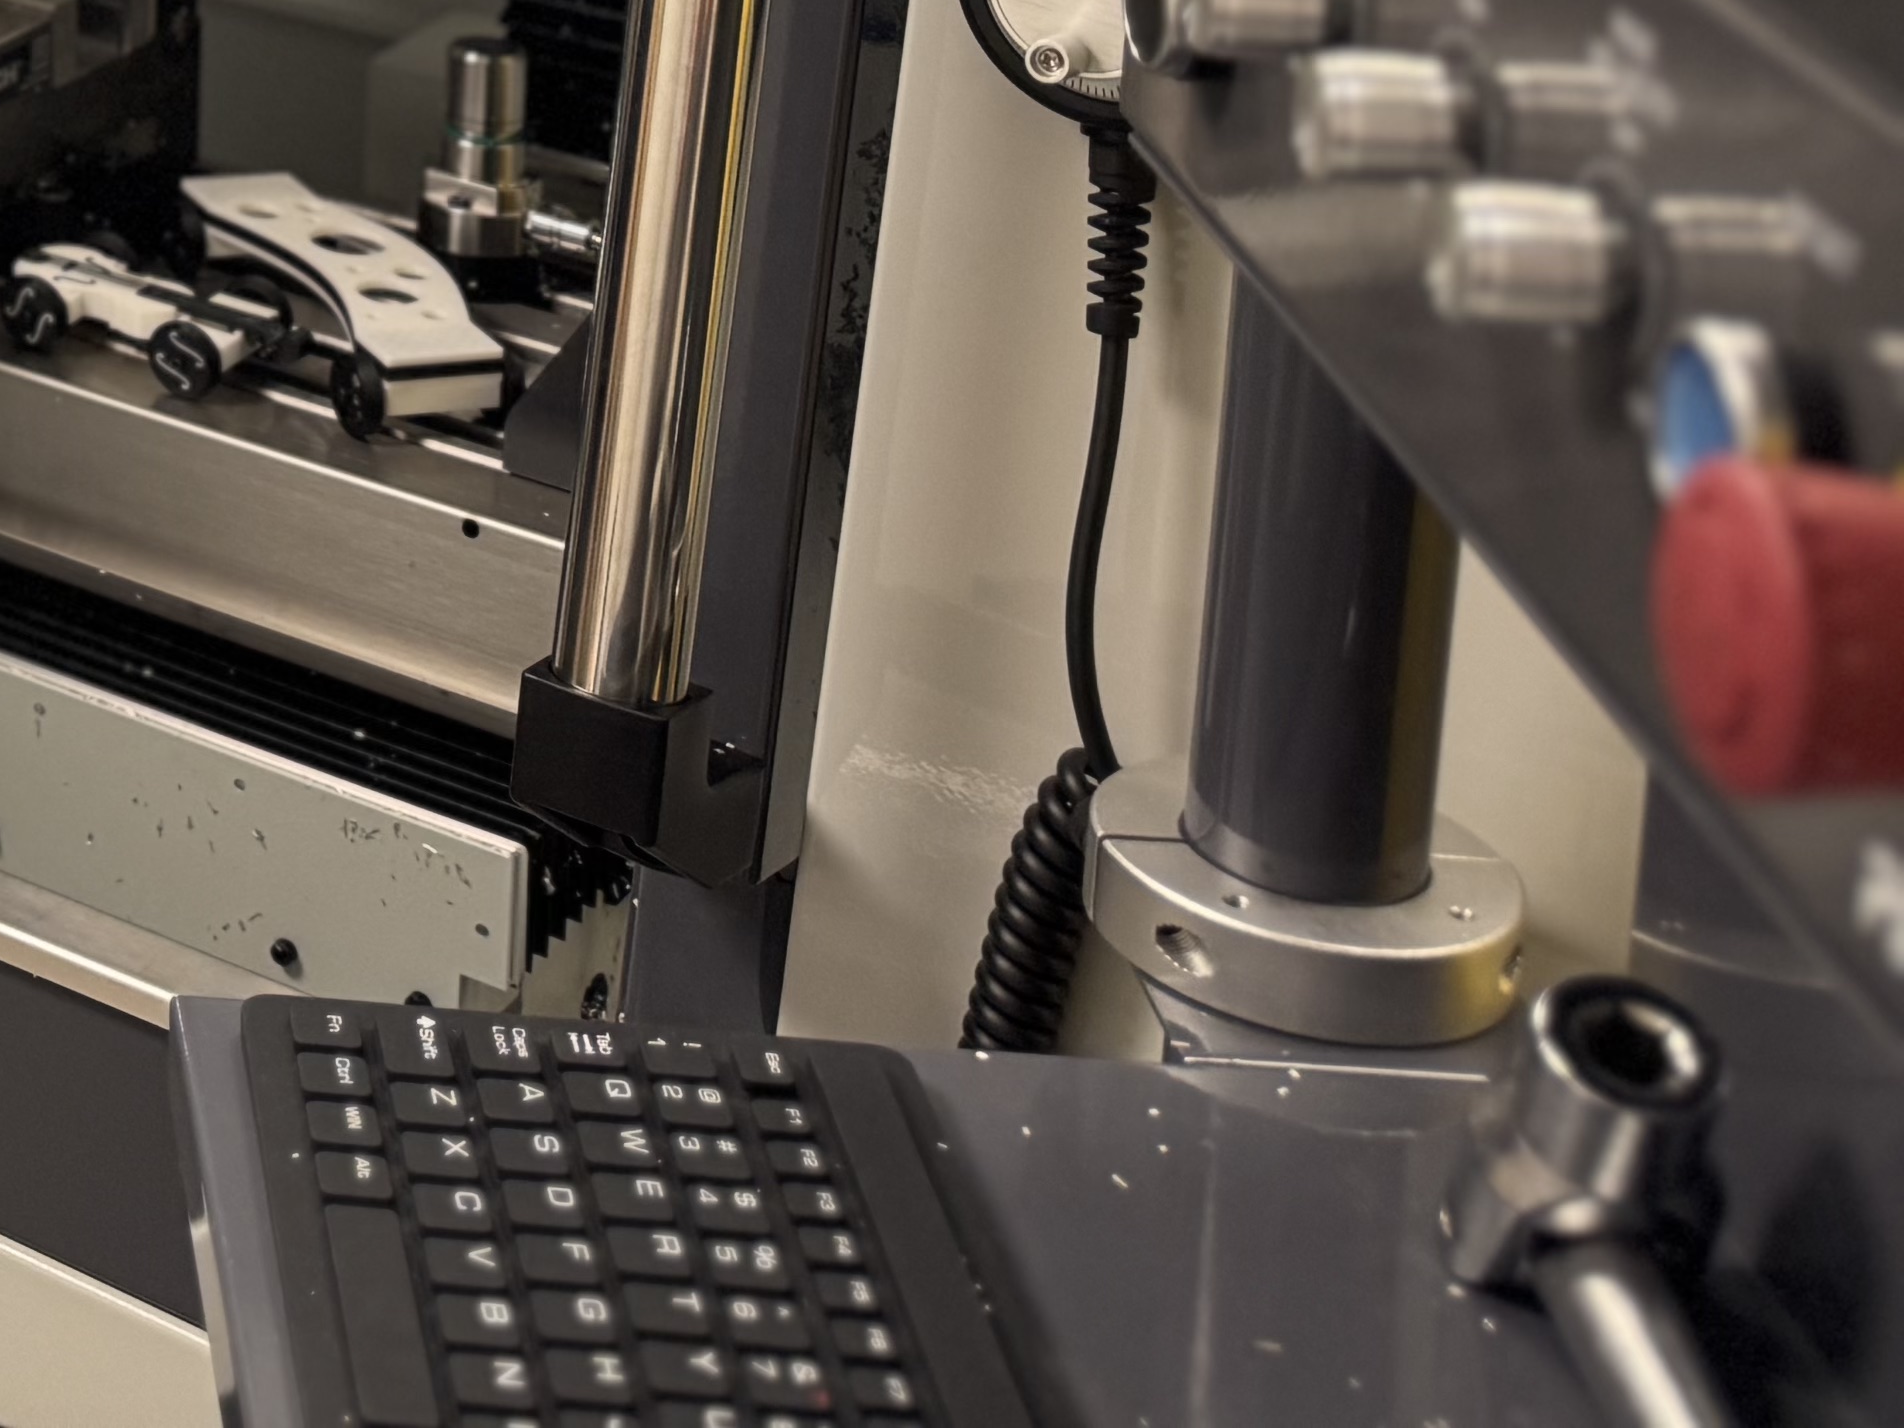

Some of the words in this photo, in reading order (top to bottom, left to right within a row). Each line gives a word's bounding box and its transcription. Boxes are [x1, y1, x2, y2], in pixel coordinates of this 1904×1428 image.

[326, 1014, 343, 1033] Fn
[419, 1028, 439, 1060] Shift
[492, 1025, 511, 1055] Lock
[512, 1027, 529, 1058] Caps
[596, 1032, 613, 1055] Tab
[647, 1037, 667, 1046] 1
[335, 1057, 354, 1085] Ctrl
[764, 1052, 782, 1074] Esc
[430, 1087, 457, 1106] Z
[518, 1082, 545, 1102] A
[605, 1078, 632, 1098] Q
[662, 1084, 683, 1099] 2
[344, 1106, 363, 1130] WIN
[785, 1107, 803, 1125] F1
[441, 1137, 470, 1157] X
[533, 1133, 560, 1154] S
[620, 1128, 650, 1155] W
[679, 1135, 701, 1151] 3
[354, 1156, 373, 1179] Alt
[800, 1148, 819, 1168] F2
[547, 1186, 574, 1207] D
[635, 1179, 664, 1198] E
[699, 1187, 719, 1204] 4
[453, 1191, 482, 1212] C
[816, 1191, 836, 1211] F3
[561, 1241, 590, 1261] F
[652, 1233, 682, 1255] R
[714, 1245, 738, 1263] 5
[467, 1246, 496, 1267] V
[479, 1301, 509, 1324] B
[577, 1297, 607, 1322] G
[672, 1292, 701, 1312] T
[732, 1301, 758, 1322] 6
[493, 1360, 526, 1387] N
[593, 1356, 624, 1382] H
[689, 1351, 720, 1375] Y
[751, 1359, 778, 1379] 7
